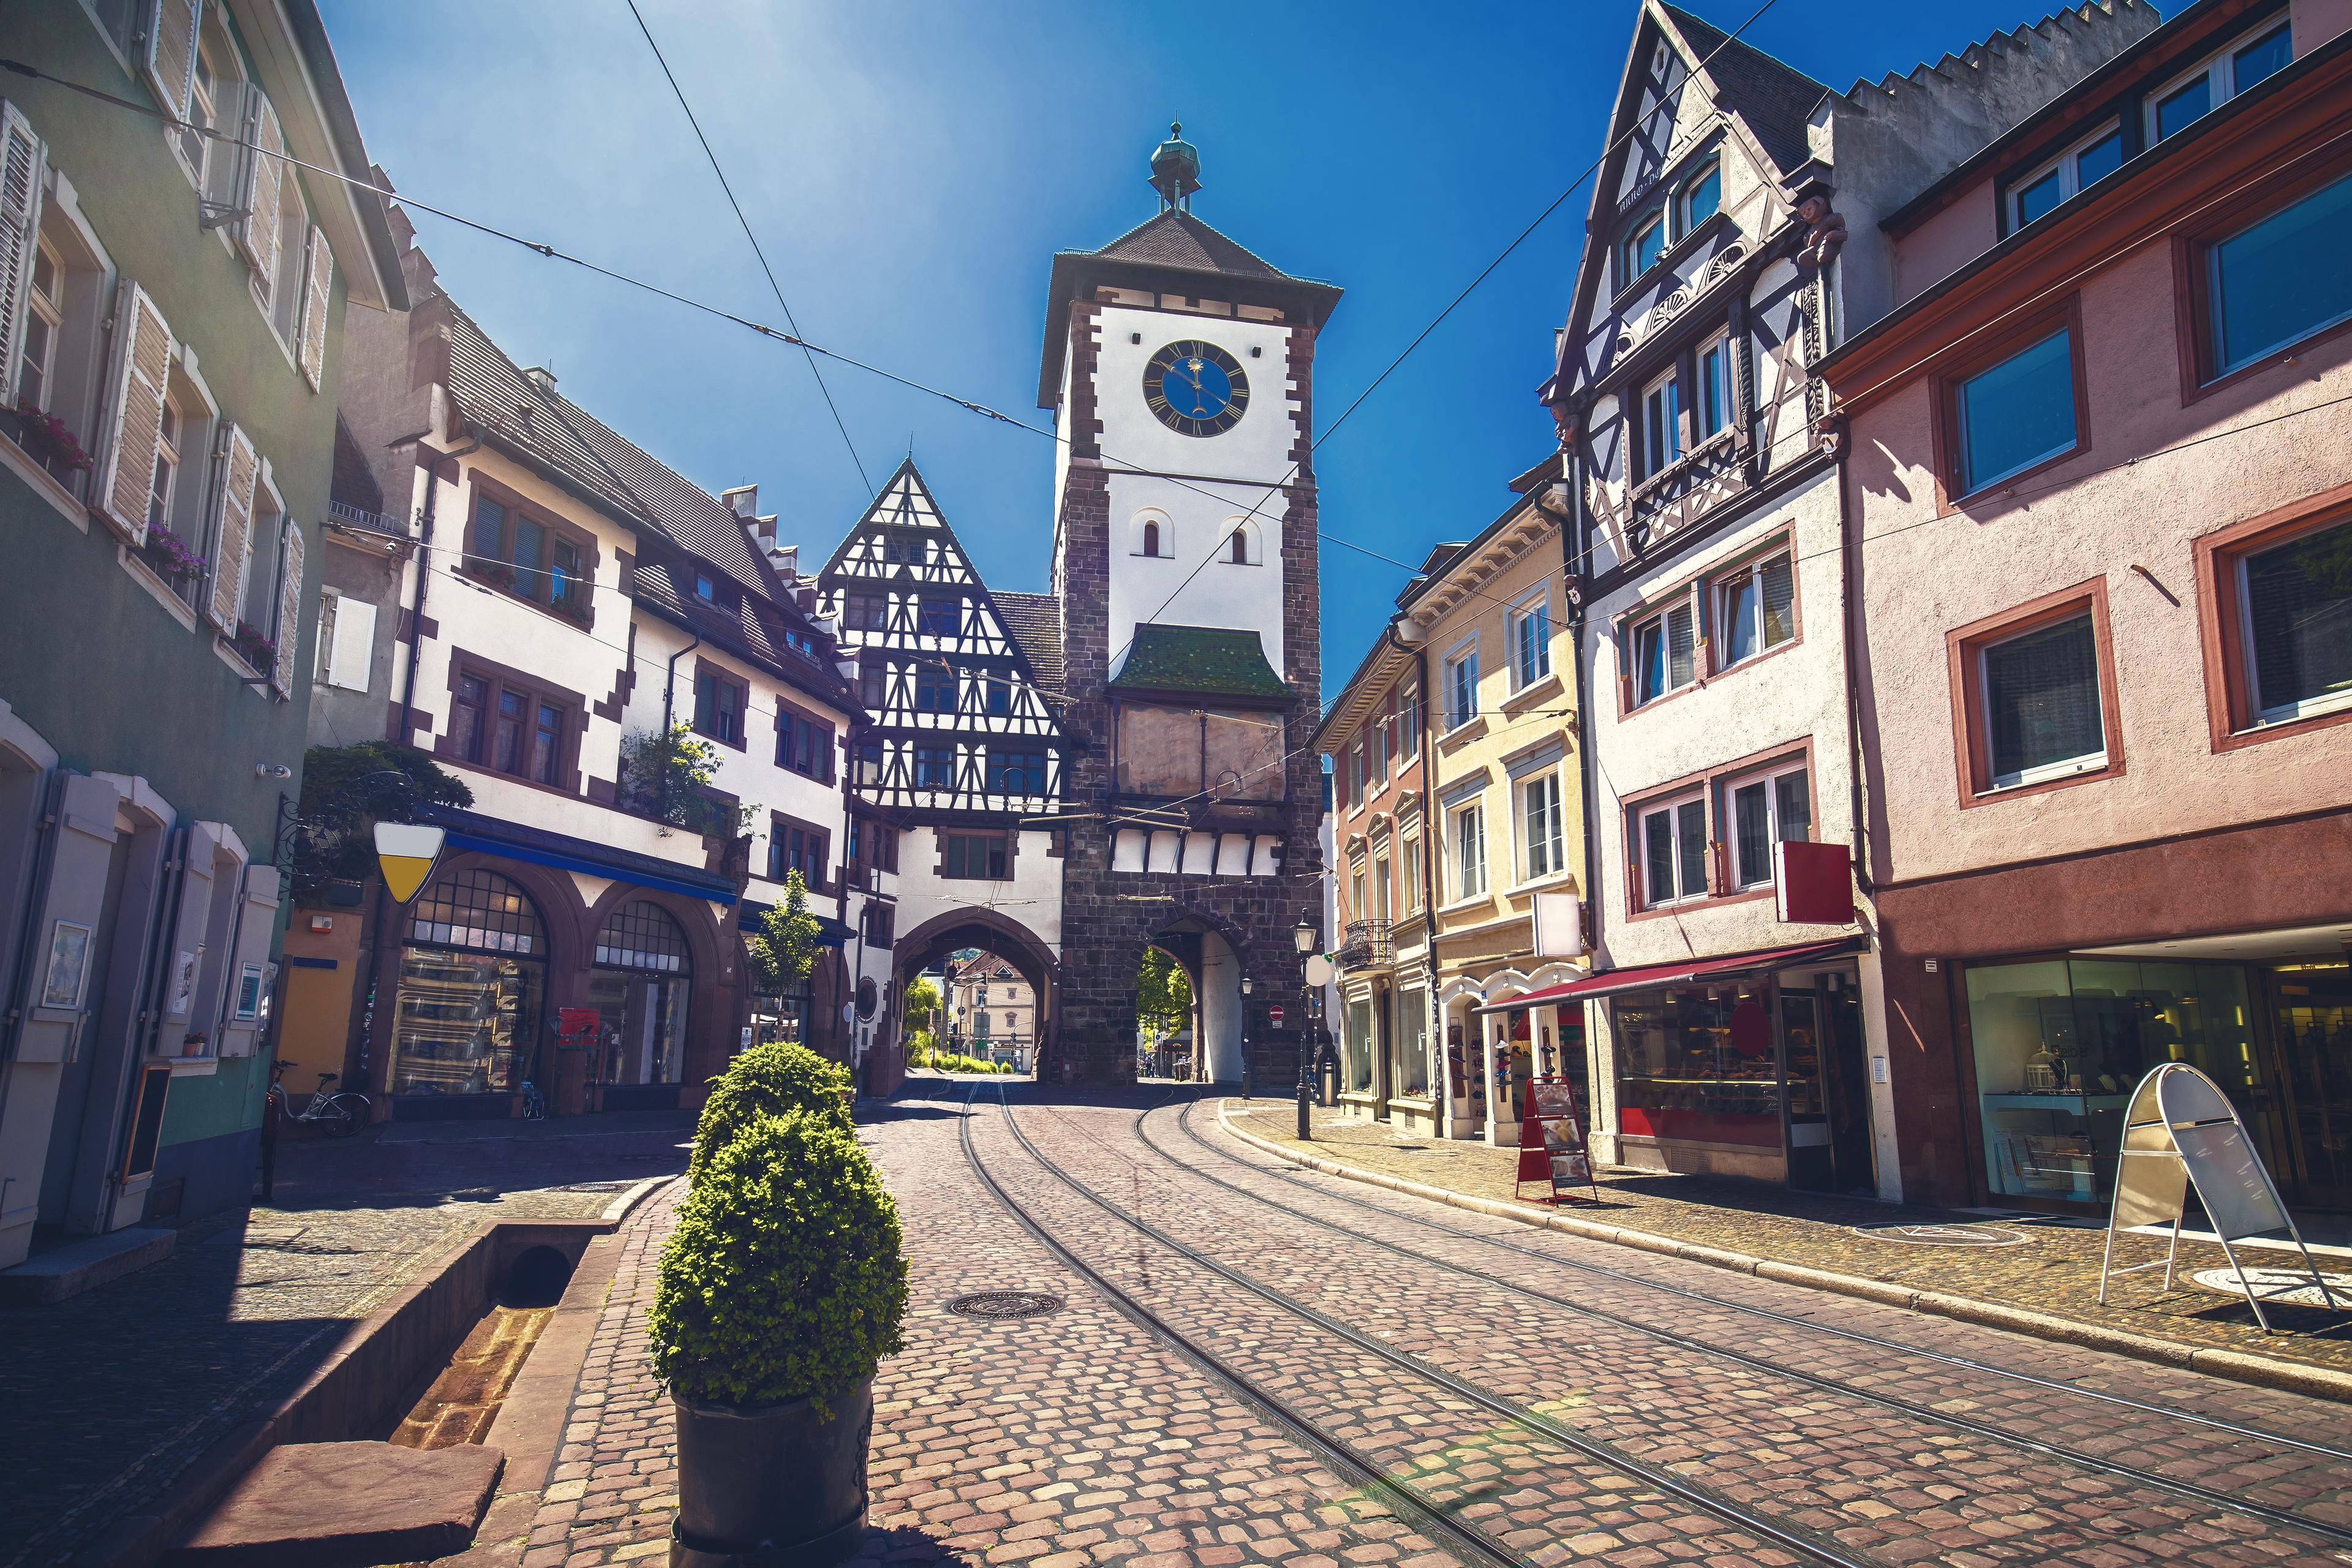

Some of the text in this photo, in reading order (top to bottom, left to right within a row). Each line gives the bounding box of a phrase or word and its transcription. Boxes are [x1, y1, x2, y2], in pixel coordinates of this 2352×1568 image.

[1619, 184, 1643, 215] ANNO
[1167, 343, 1183, 360] XI
[1191, 341, 1204, 356] XII
[1215, 350, 1224, 363] I
[1227, 368, 1243, 377] II
[1145, 377, 1162, 387] IX
[1232, 388, 1248, 398] III
[1148, 395, 1168, 413] VIII
[1225, 404, 1243, 420] IIII
[1166, 411, 1182, 429] VII
[1193, 420, 1202, 435] VI
[1215, 418, 1225, 433] V
